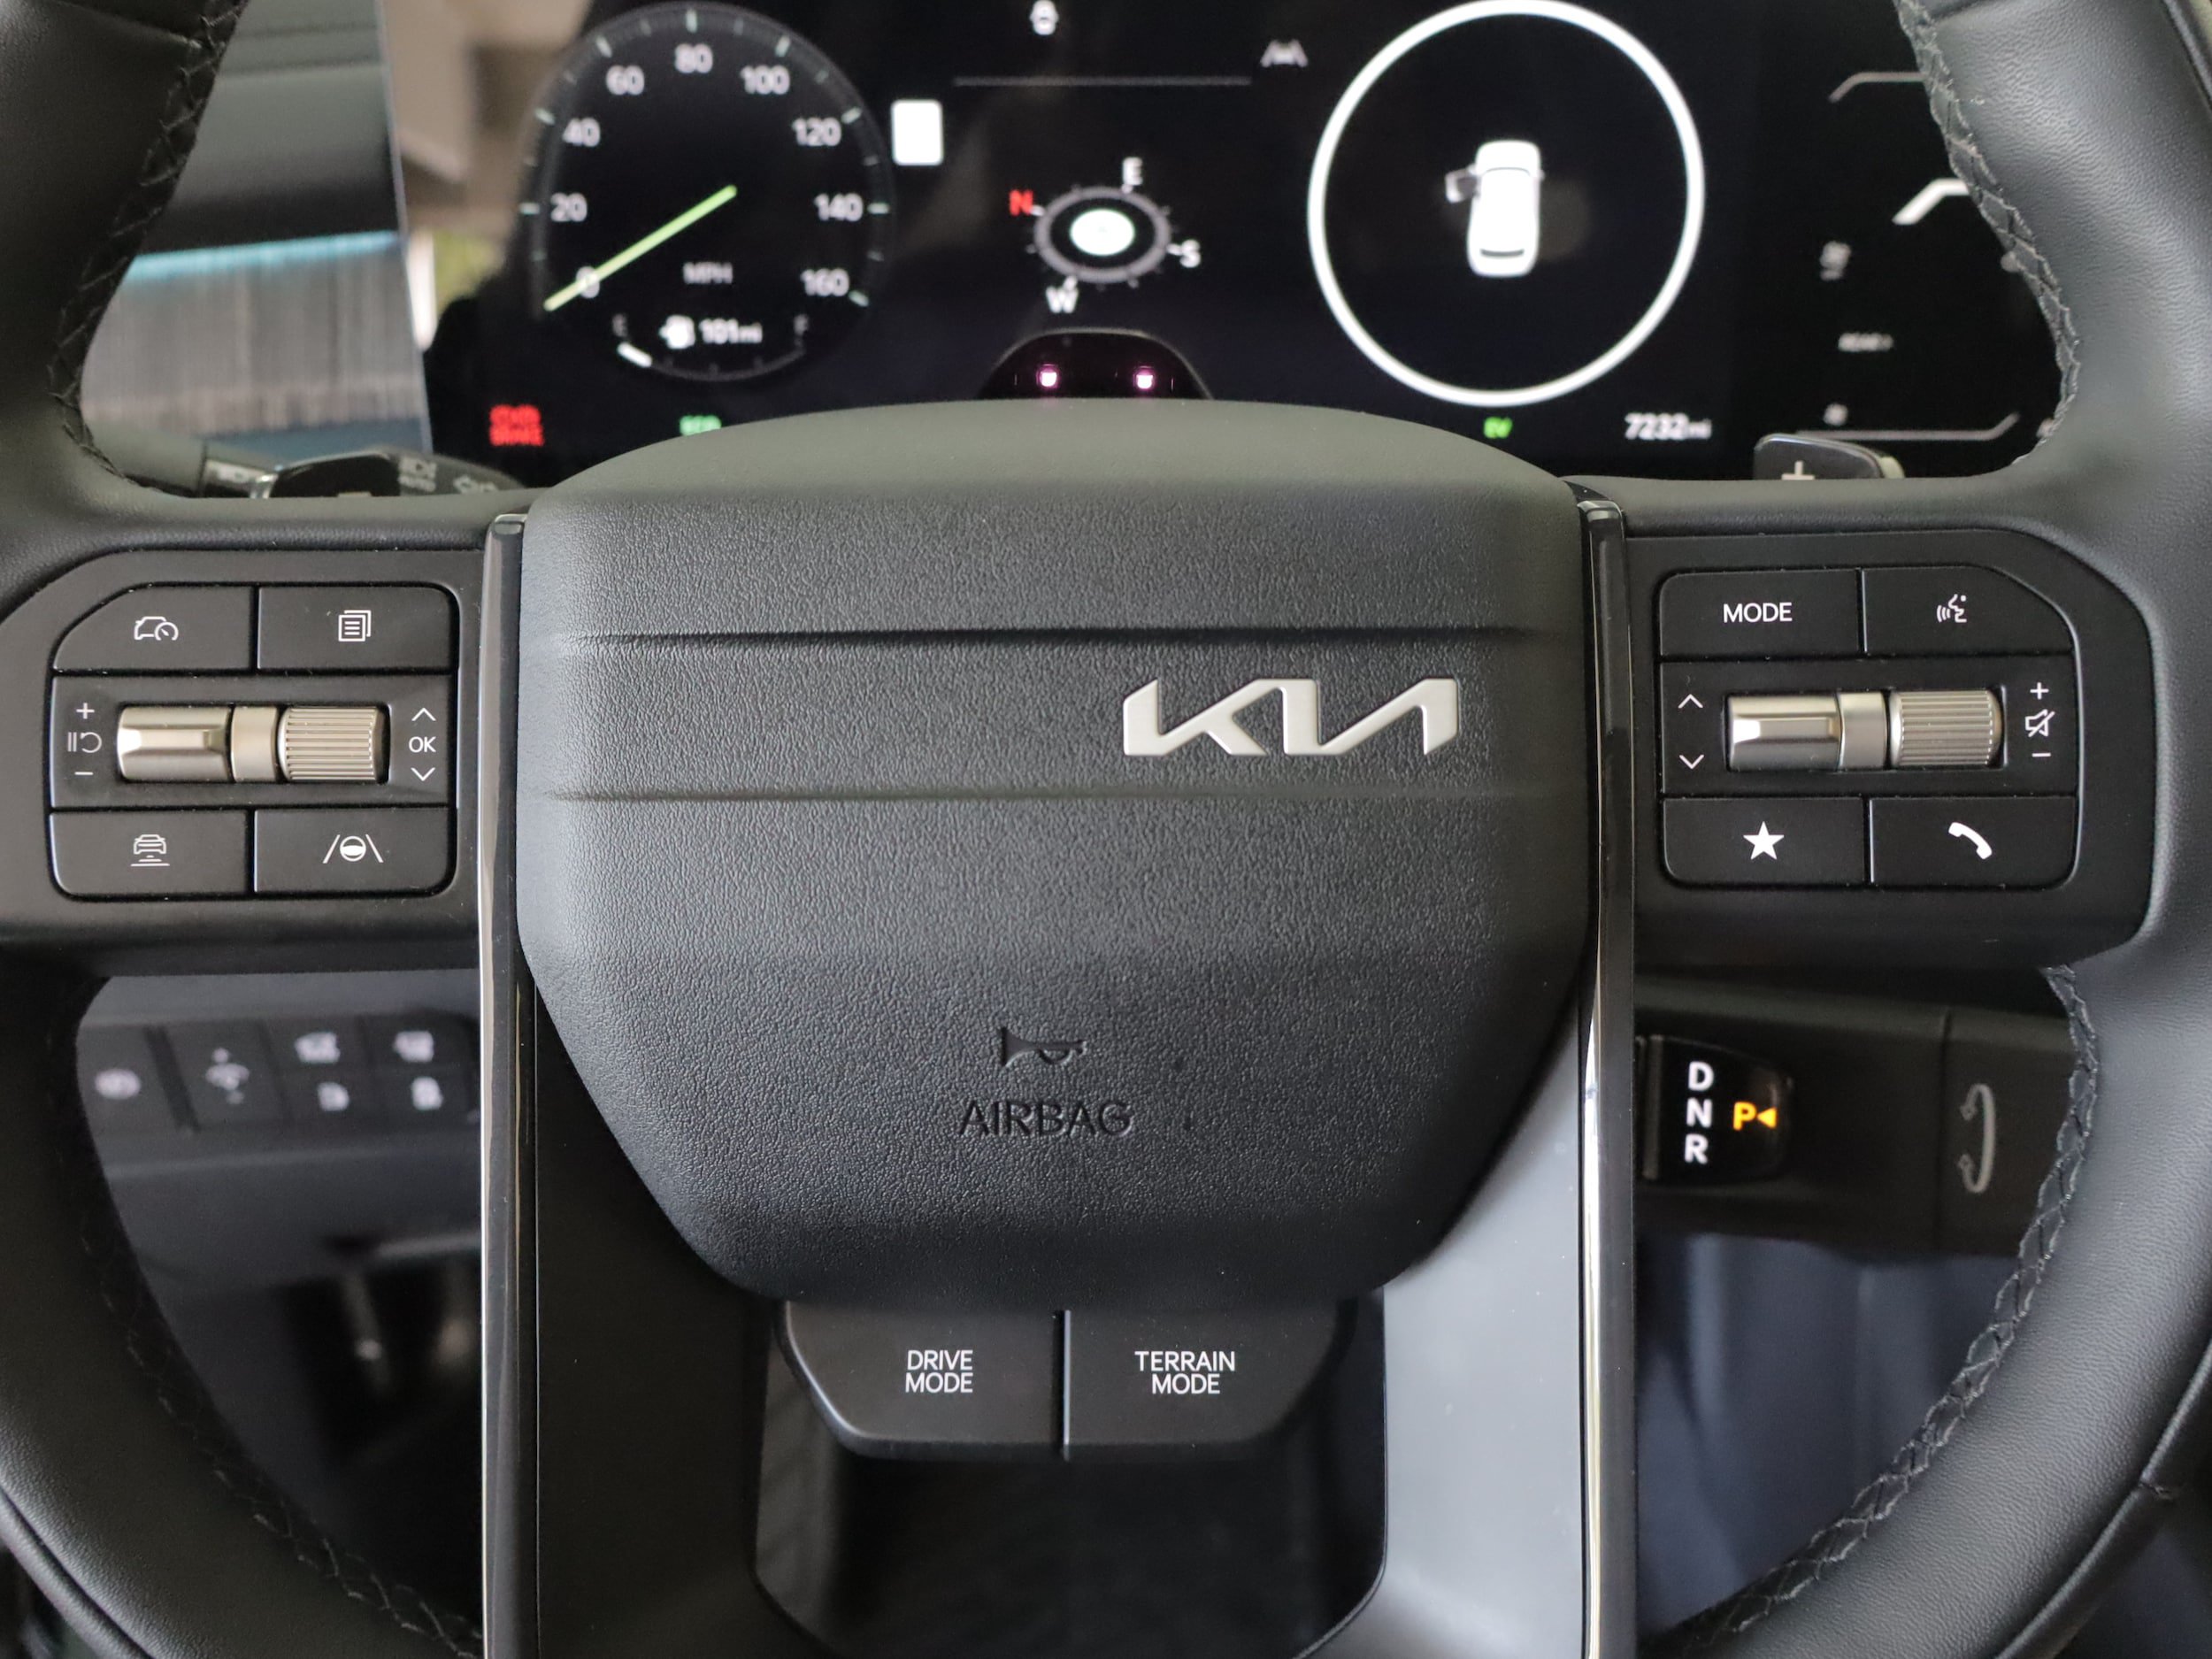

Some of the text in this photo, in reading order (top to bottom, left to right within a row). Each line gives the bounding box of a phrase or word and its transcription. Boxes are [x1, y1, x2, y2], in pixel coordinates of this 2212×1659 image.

[674, 43, 713, 73] 80
[605, 65, 646, 96] 60
[740, 65, 790, 95] 100
[562, 117, 602, 147] 40
[793, 117, 841, 147] 120
[1122, 157, 1142, 185] E
[550, 193, 588, 222] 20
[814, 193, 864, 222] 140
[1009, 189, 1033, 216] N
[1179, 239, 1202, 268] S
[682, 262, 733, 284] MPH
[801, 269, 849, 296] 160
[1046, 286, 1079, 313] W
[1723, 602, 1793, 623] MODE
[408, 736, 437, 753] OK
[1688, 1061, 1714, 1091] D
[959, 1100, 1133, 1138] AIRBAG
[1686, 1097, 1712, 1128] N
[1733, 1101, 1755, 1131] P
[1684, 1133, 1709, 1164] R
[907, 1349, 973, 1371] DRIVE
[1134, 1350, 1236, 1372] TERRAIN
[904, 1372, 973, 1394] MODE
[1152, 1373, 1220, 1394] MODE
